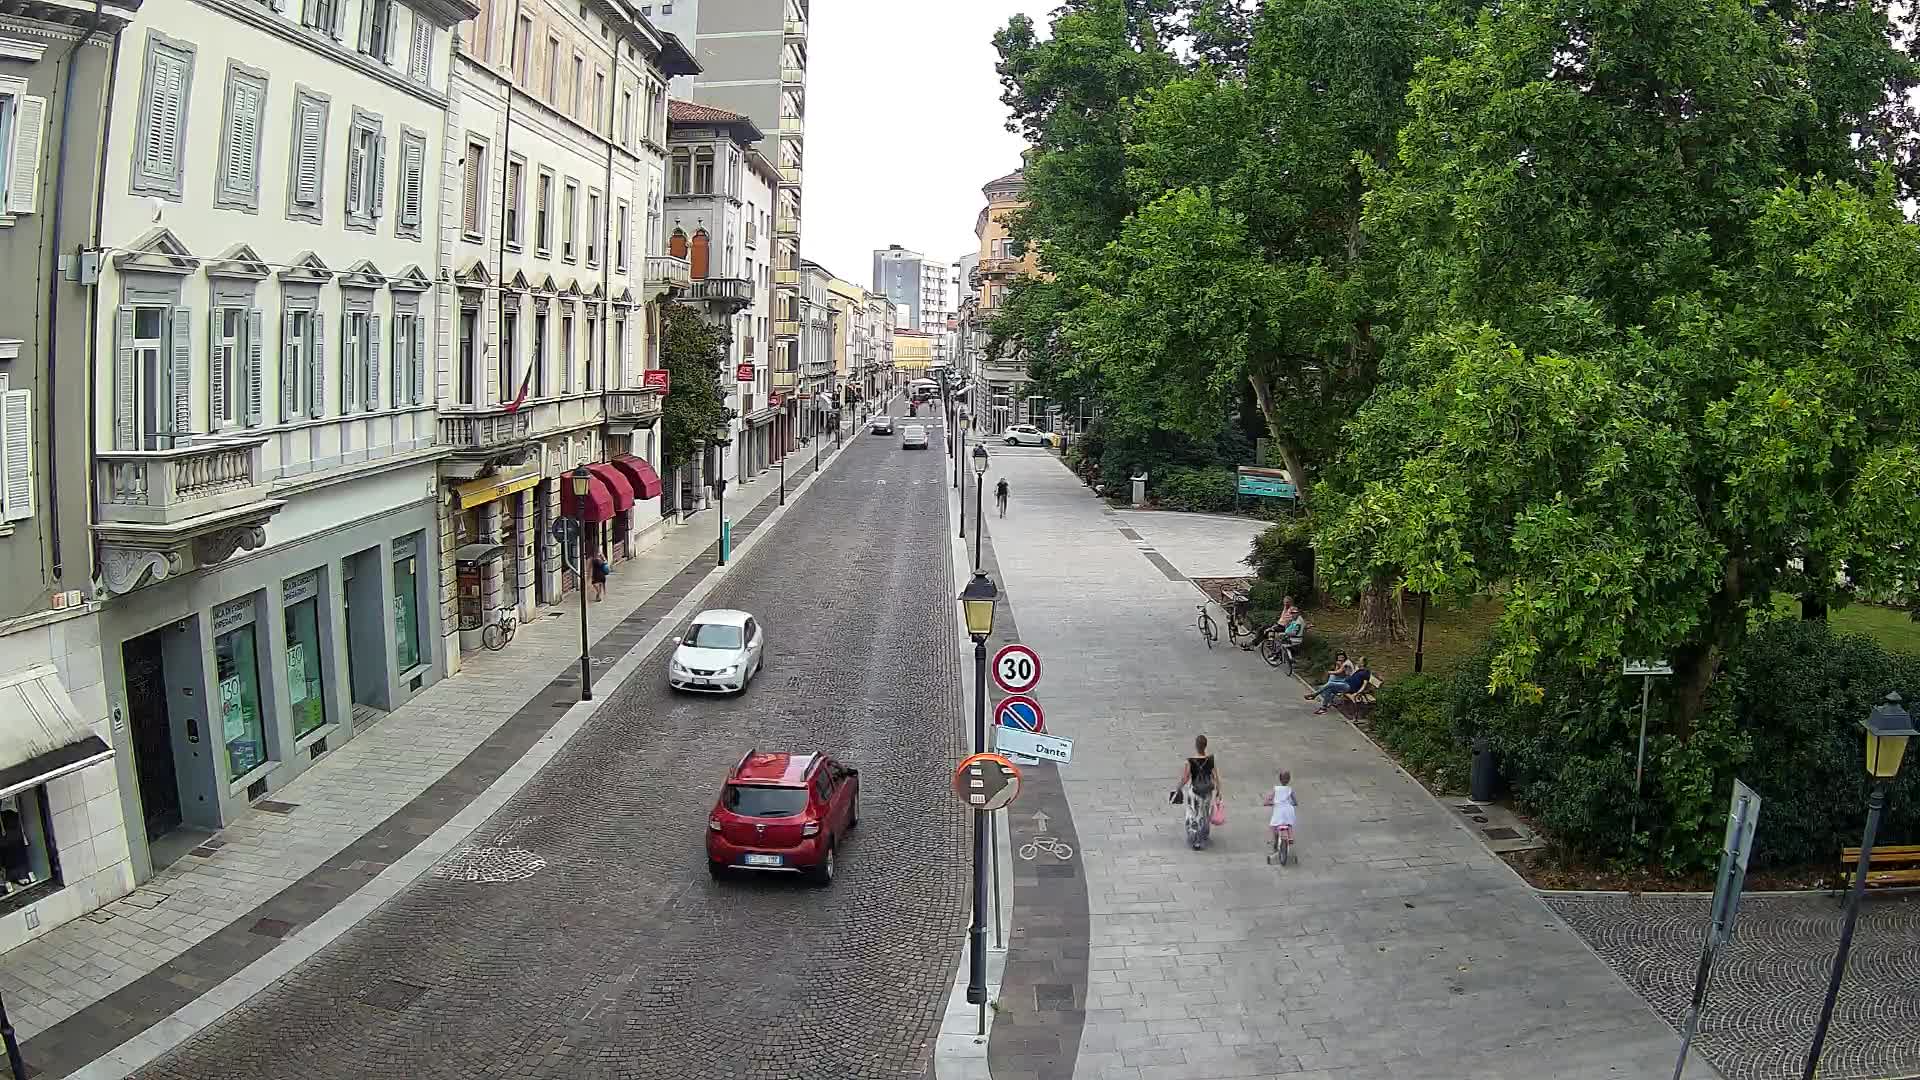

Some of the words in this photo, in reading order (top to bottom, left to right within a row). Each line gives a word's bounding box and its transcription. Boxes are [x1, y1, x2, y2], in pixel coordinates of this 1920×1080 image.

[1003, 658, 1031, 680] 30
[221, 679, 239, 701] 130
[1035, 744, 1067, 758] Dante
